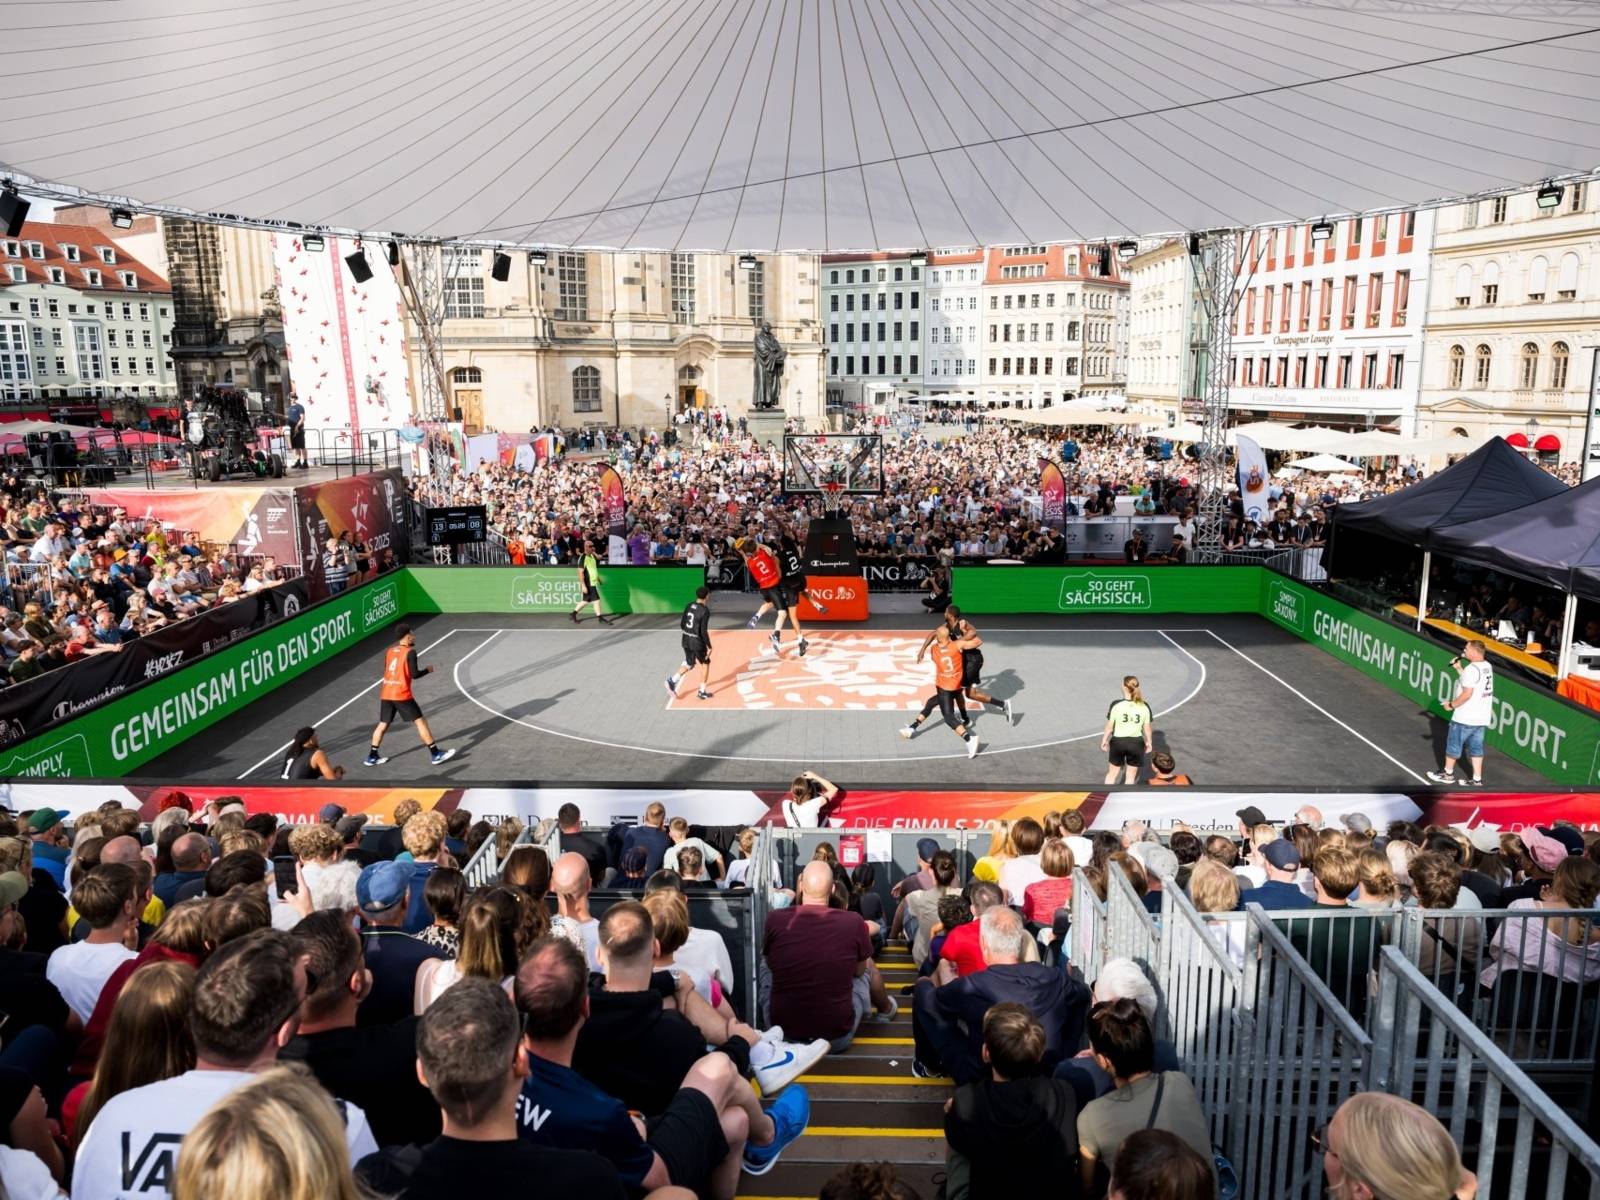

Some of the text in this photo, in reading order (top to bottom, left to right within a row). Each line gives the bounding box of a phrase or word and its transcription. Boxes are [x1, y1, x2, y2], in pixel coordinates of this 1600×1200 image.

[1273, 334, 1334, 347] Champagner Lounge
[374, 532, 390, 552] 2025
[756, 561, 770, 574] 2
[789, 556, 799, 570] 2
[810, 560, 850, 568] Champion
[862, 566, 900, 580] ING
[538, 581, 581, 592] SO GEHT
[1088, 581, 1135, 591] SO GEHT
[805, 588, 833, 600] NG
[1066, 589, 1145, 605] SÄCHSISCH.
[685, 612, 695, 629] 3
[1313, 609, 1395, 675] GEMEINSAM
[1398, 650, 1434, 697] FÜR
[388, 656, 398, 676] 4
[941, 656, 954, 673] 3
[110, 610, 355, 761] GEMEINSAM FÜR DEN SPORT.
[52, 683, 126, 721] Champion
[280, 757, 294, 780] 1
[891, 816, 967, 830] FINALS
